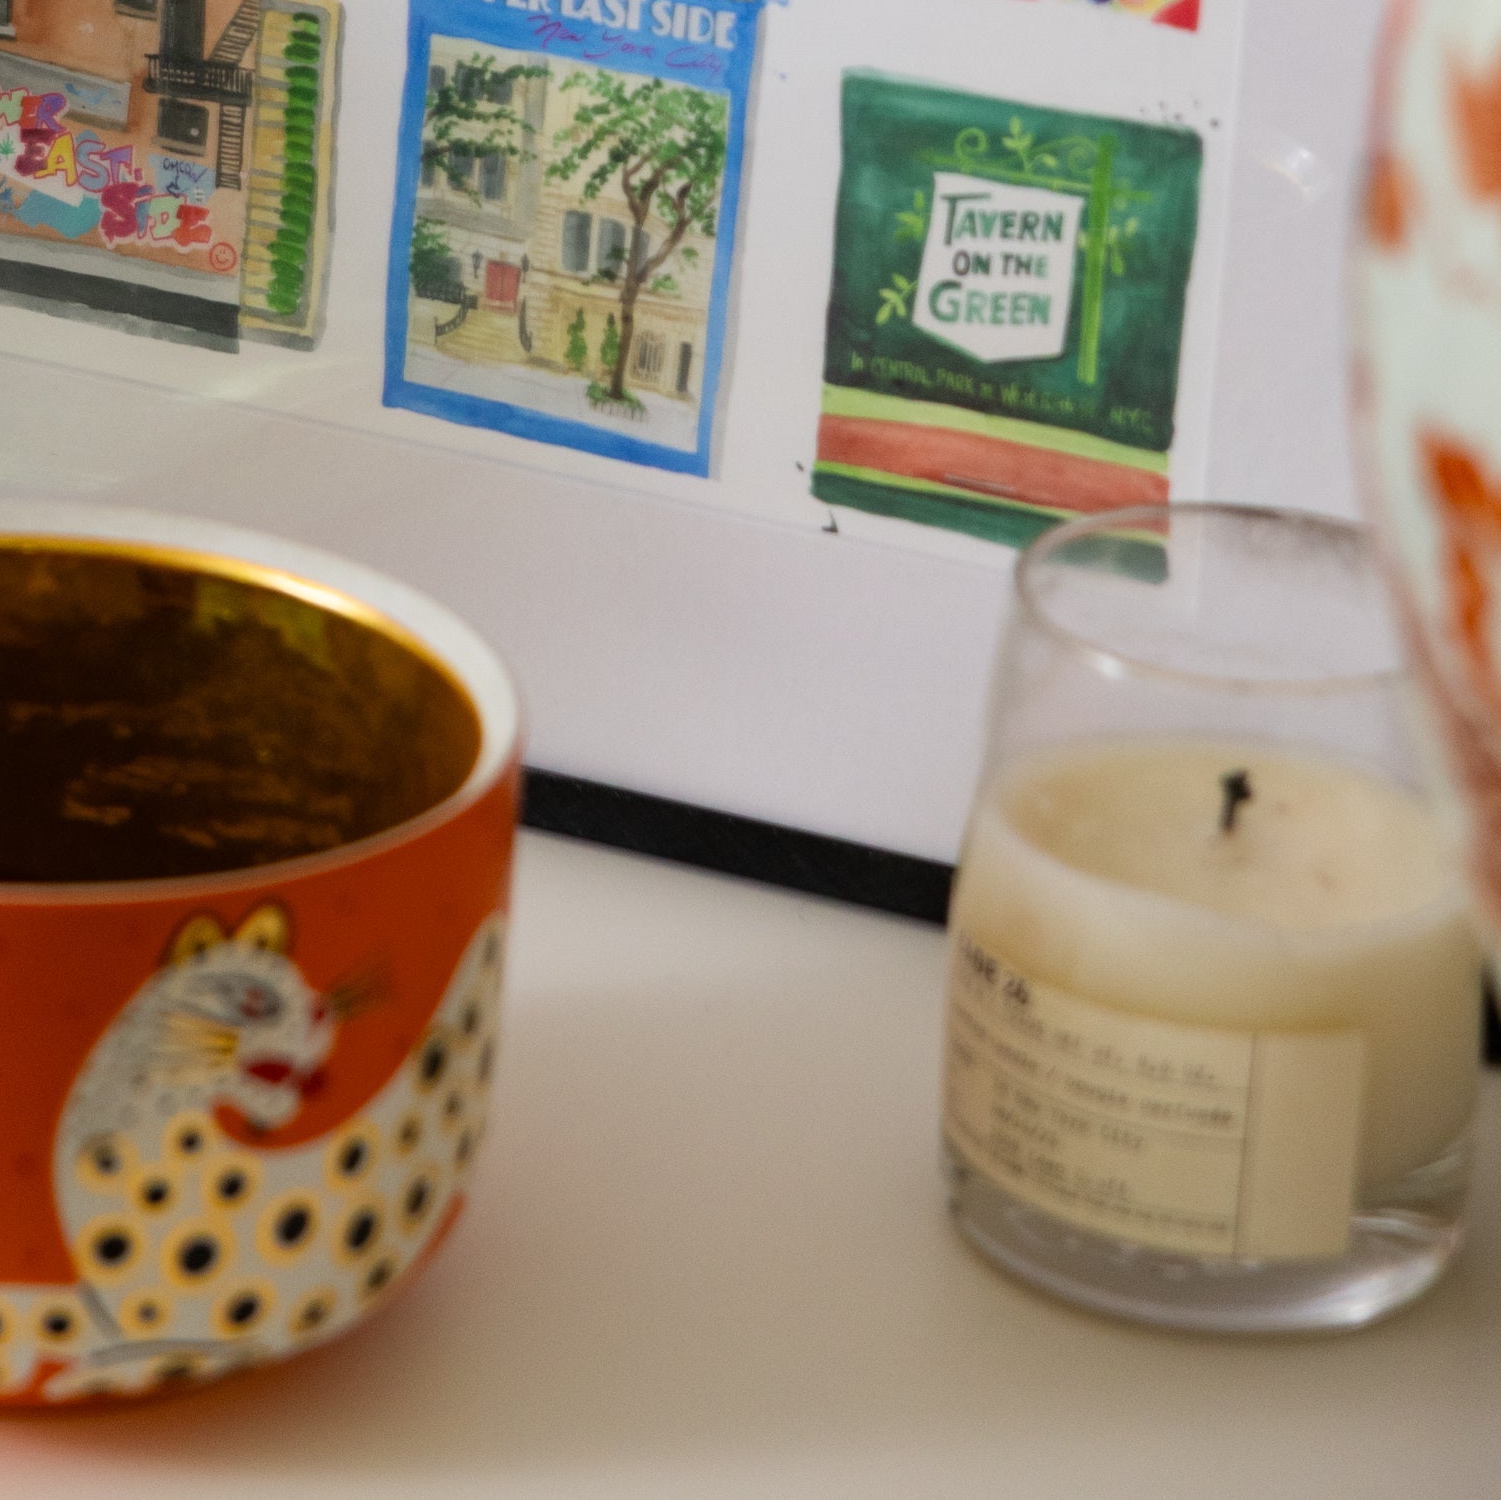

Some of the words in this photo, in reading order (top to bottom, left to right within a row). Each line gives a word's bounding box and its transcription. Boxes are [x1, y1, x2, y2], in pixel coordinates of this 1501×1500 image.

[527, 13, 587, 50] New
[14, 126, 135, 195] EAST
[939, 191, 1065, 247] TAVERN
[951, 248, 991, 278] ON
[1002, 251, 1049, 279] THE
[927, 278, 1053, 327] GREEN
